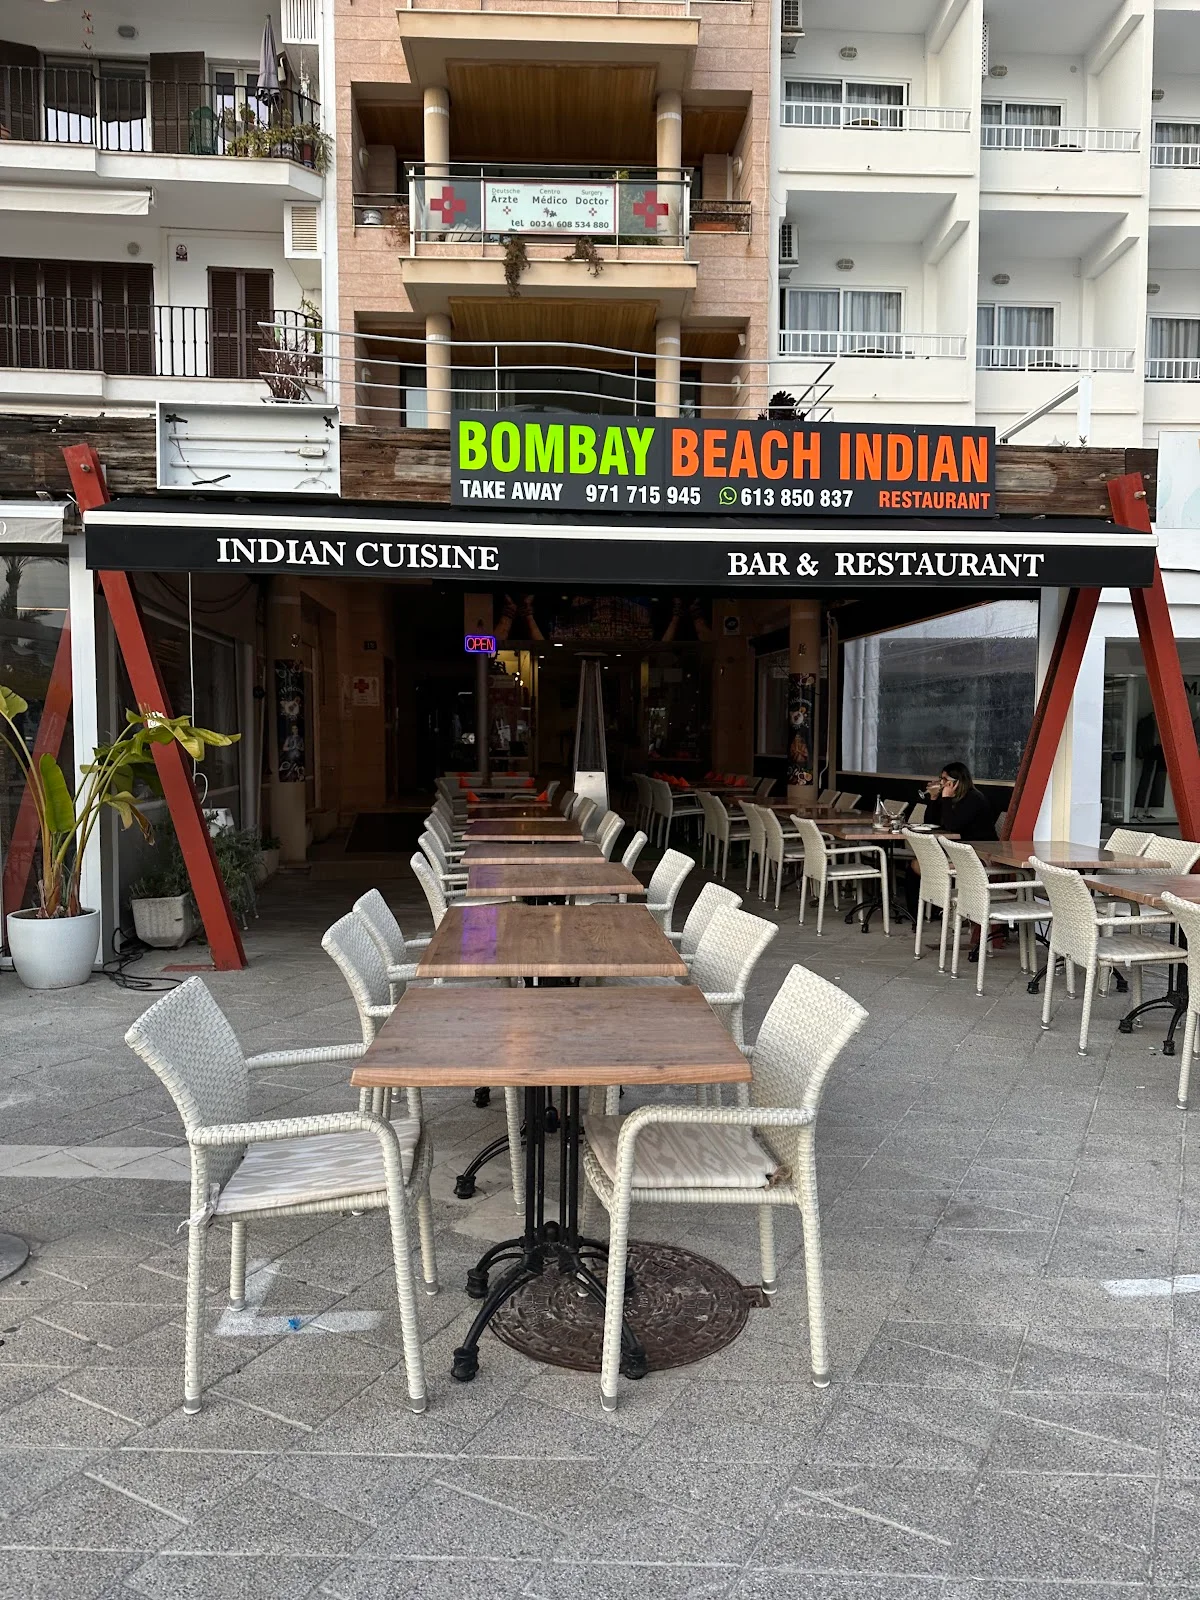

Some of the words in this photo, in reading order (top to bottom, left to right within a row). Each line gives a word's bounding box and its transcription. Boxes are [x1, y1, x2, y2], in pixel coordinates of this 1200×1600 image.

[491, 193, 518, 203] Ärzte
[532, 195, 568, 205] Médico
[575, 196, 609, 205] Doctor
[511, 219, 524, 227] tel
[593, 221, 609, 229] 880
[459, 420, 655, 476] BOMBAY
[672, 428, 821, 480] BEACH
[839, 432, 988, 483] INDIAN
[460, 479, 505, 499] TAKE
[511, 482, 563, 501] AWAY
[586, 484, 619, 503] 971
[627, 485, 661, 504] 715
[667, 486, 701, 505] 945
[740, 487, 775, 506] 613
[780, 488, 814, 507] 850
[820, 490, 853, 508] 837
[879, 490, 991, 510] RESTAURANT
[216, 537, 346, 566] INDIAN
[355, 542, 500, 571] CUISINE
[727, 552, 790, 576] BAR
[796, 552, 819, 576] &
[835, 552, 1044, 577] RESTAURANT
[466, 637, 494, 651] OPEN
